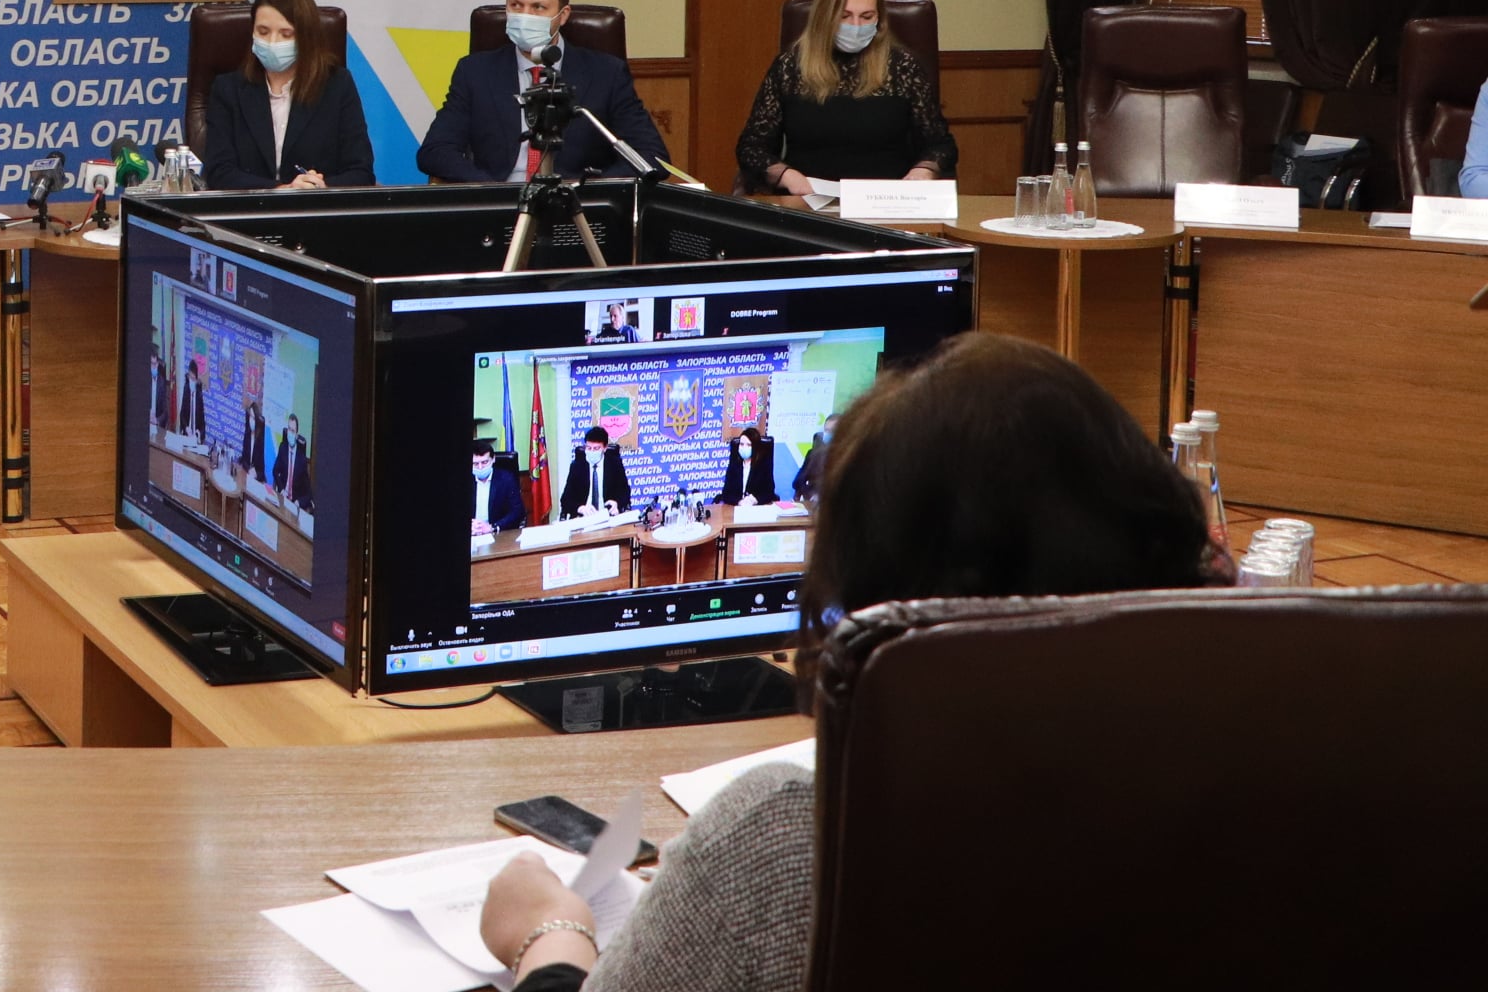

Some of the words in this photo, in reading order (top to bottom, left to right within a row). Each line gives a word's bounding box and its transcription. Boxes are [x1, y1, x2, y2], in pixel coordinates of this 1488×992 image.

[11, 37, 171, 67] ОБЛАСТЬ
[731, 310, 752, 319] DOBRE
[753, 308, 778, 318] Program
[575, 362, 629, 375] ЗАПОРІЗЬКА
[630, 359, 669, 372] ОБЛАСТЬ
[676, 355, 728, 368] ЗАПОРІЗЬКА
[729, 352, 767, 365] ОБЛАСТЬ
[666, 647, 697, 656] SAMSUNG
